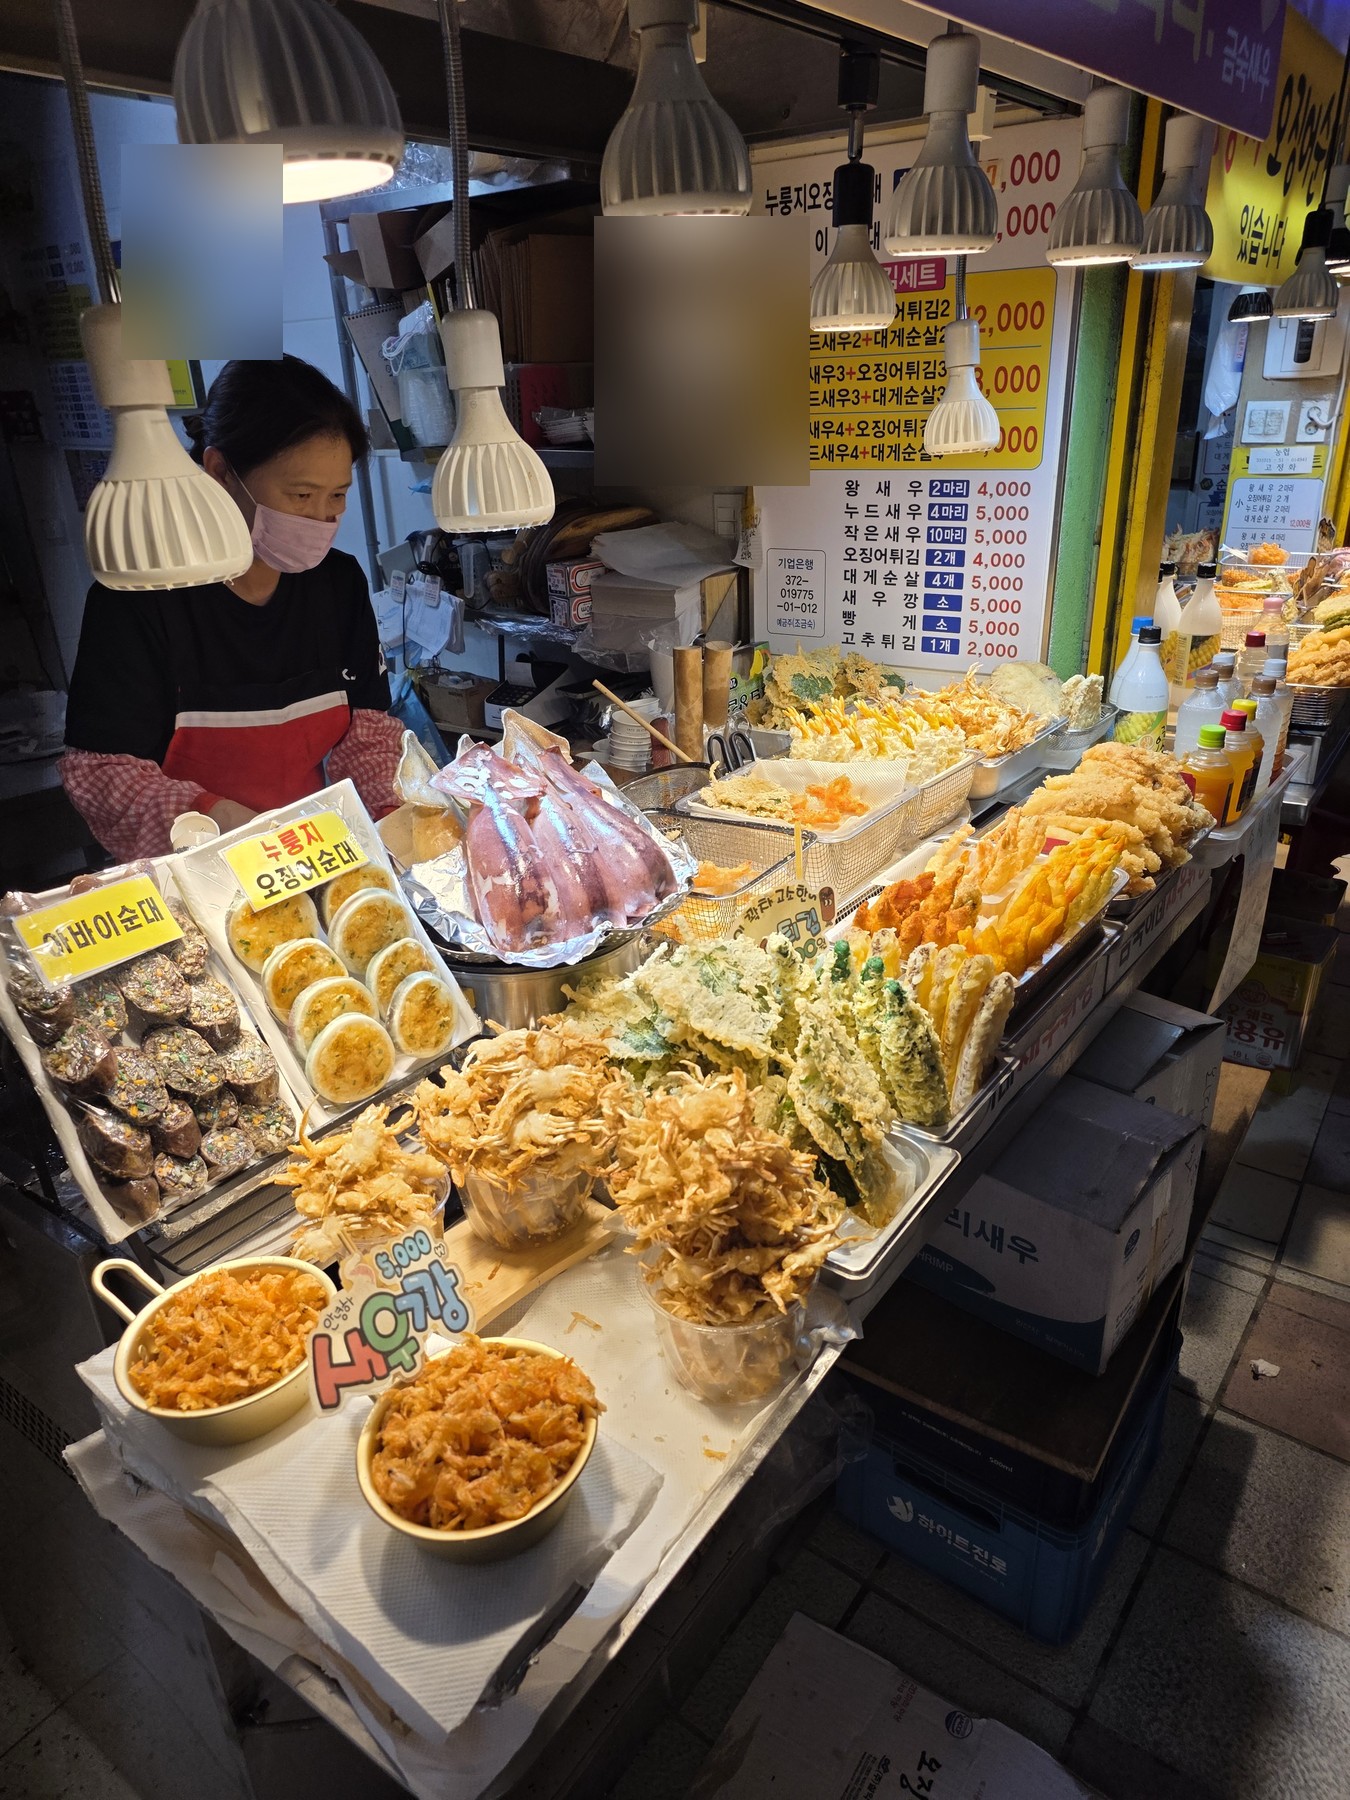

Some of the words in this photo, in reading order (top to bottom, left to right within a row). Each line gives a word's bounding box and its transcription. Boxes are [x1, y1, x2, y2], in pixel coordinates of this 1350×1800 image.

[1237, 204, 1288, 269] 있습니다
[931, 481, 968, 497] 2마리
[977, 481, 1031, 498] 4,000
[930, 504, 967, 520] 4마리
[976, 505, 1029, 523] 5,000
[929, 528, 965, 543] 10마리
[974, 529, 1027, 547] 5,000
[778, 558, 814, 571] 기업은행
[843, 547, 920, 566] 오징어튀김
[932, 551, 956, 565] 2개
[972, 552, 1026, 570] 4,000
[786, 575, 808, 586] 372-
[932, 573, 955, 587] 4개
[971, 575, 1024, 592] 5,000
[780, 588, 814, 600] 019775
[777, 602, 818, 614] -01-012
[936, 596, 950, 609] 소
[970, 598, 1021, 615] 5,000
[935, 618, 948, 631] 소
[968, 620, 1020, 637] 5,000
[930, 638, 951, 652] 1개
[967, 641, 1018, 658] 2,000
[261, 820, 325, 862] 누룽지
[255, 840, 359, 901] 오징어순대
[42, 896, 165, 958] 아바이순대
[375, 1230, 432, 1279] 5,000
[916, 1250, 954, 1273] HRIMP
[312, 1259, 469, 1409] 새우깡
[918, 1513, 1008, 1576] 하이트진로
